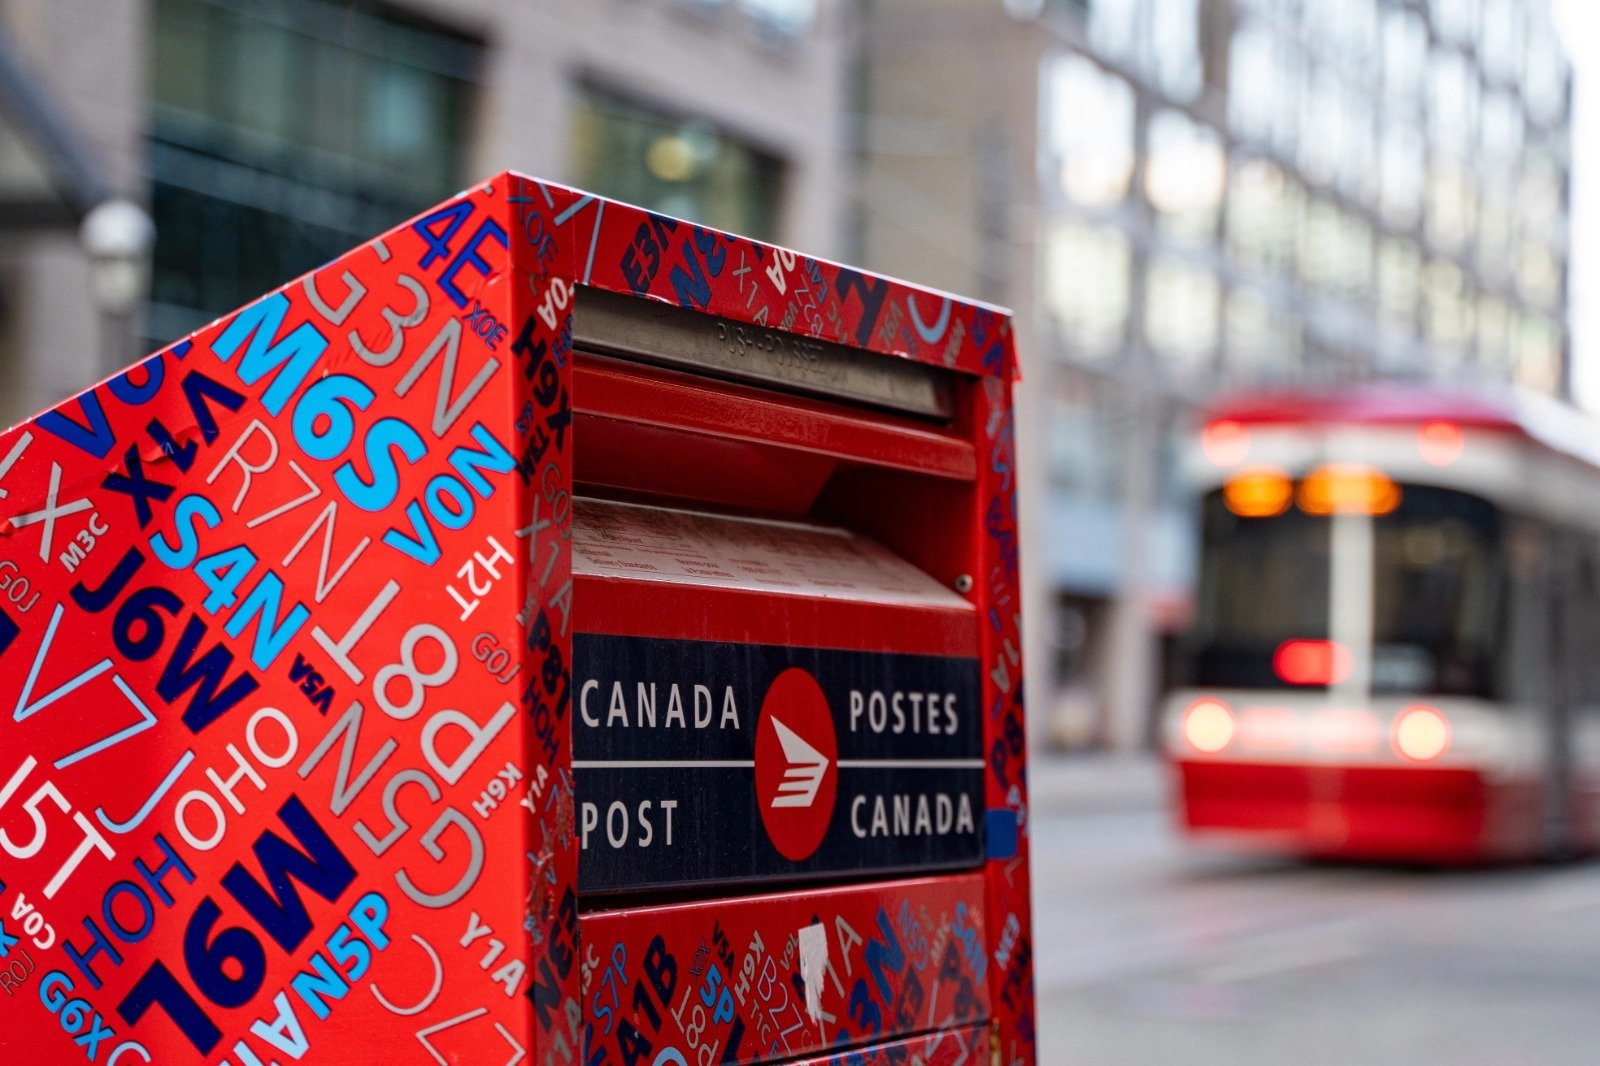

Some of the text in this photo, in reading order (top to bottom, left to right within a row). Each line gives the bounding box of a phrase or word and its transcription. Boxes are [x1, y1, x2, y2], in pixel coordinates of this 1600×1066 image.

[210, 291, 429, 512] M6S
[59, 512, 109, 574] M3C
[205, 418, 372, 603] R7N
[149, 493, 311, 673] S4N
[69, 545, 260, 735] J6W
[580, 679, 740, 730] CANADA
[849, 690, 959, 735] POSTES
[580, 799, 678, 851] POST
[849, 793, 975, 838] CANADA
[289, 890, 391, 1021] N5P
[458, 911, 527, 998] Y1A
[38, 969, 116, 1063] G6X
